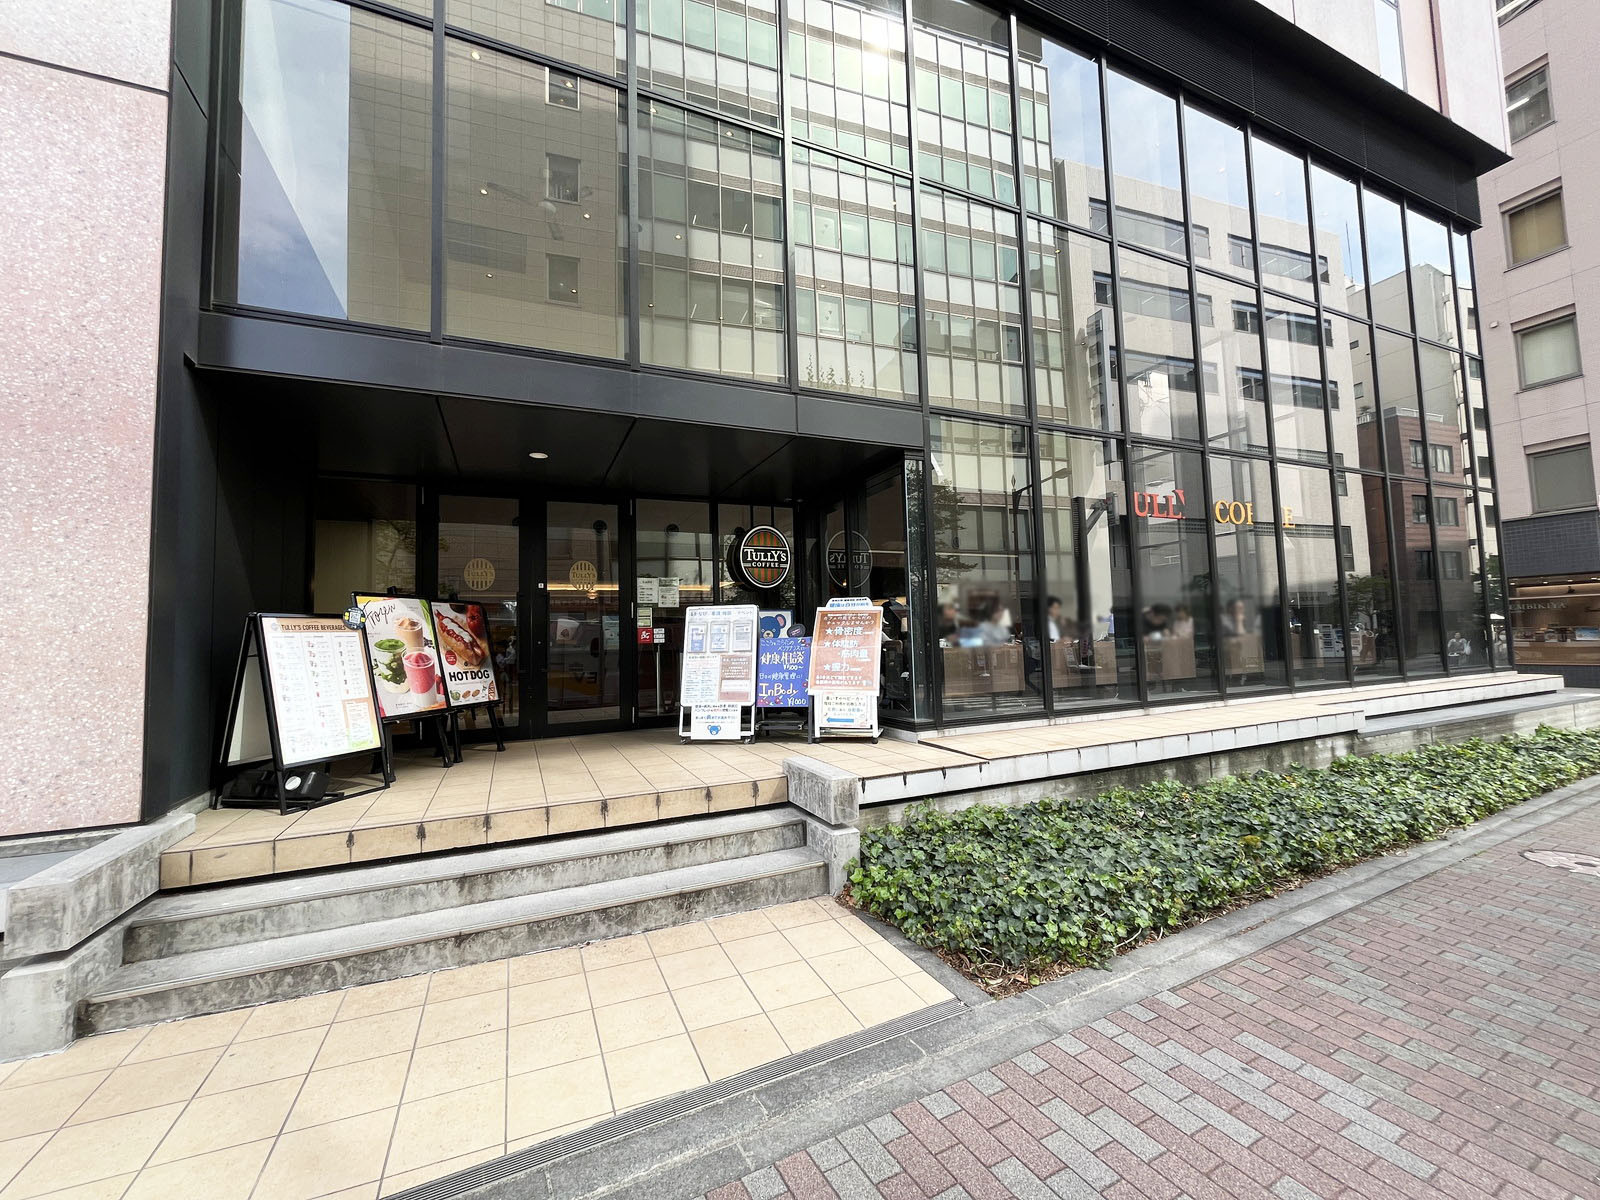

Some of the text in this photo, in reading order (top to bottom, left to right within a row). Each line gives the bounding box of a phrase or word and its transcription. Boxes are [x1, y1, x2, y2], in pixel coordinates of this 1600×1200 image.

[744, 549, 787, 562] TULLY'S
[834, 626, 864, 636] 骨密度
[760, 651, 805, 665] 健康相談
[448, 669, 490, 682] HOT DOG
[758, 682, 799, 696] InBody
